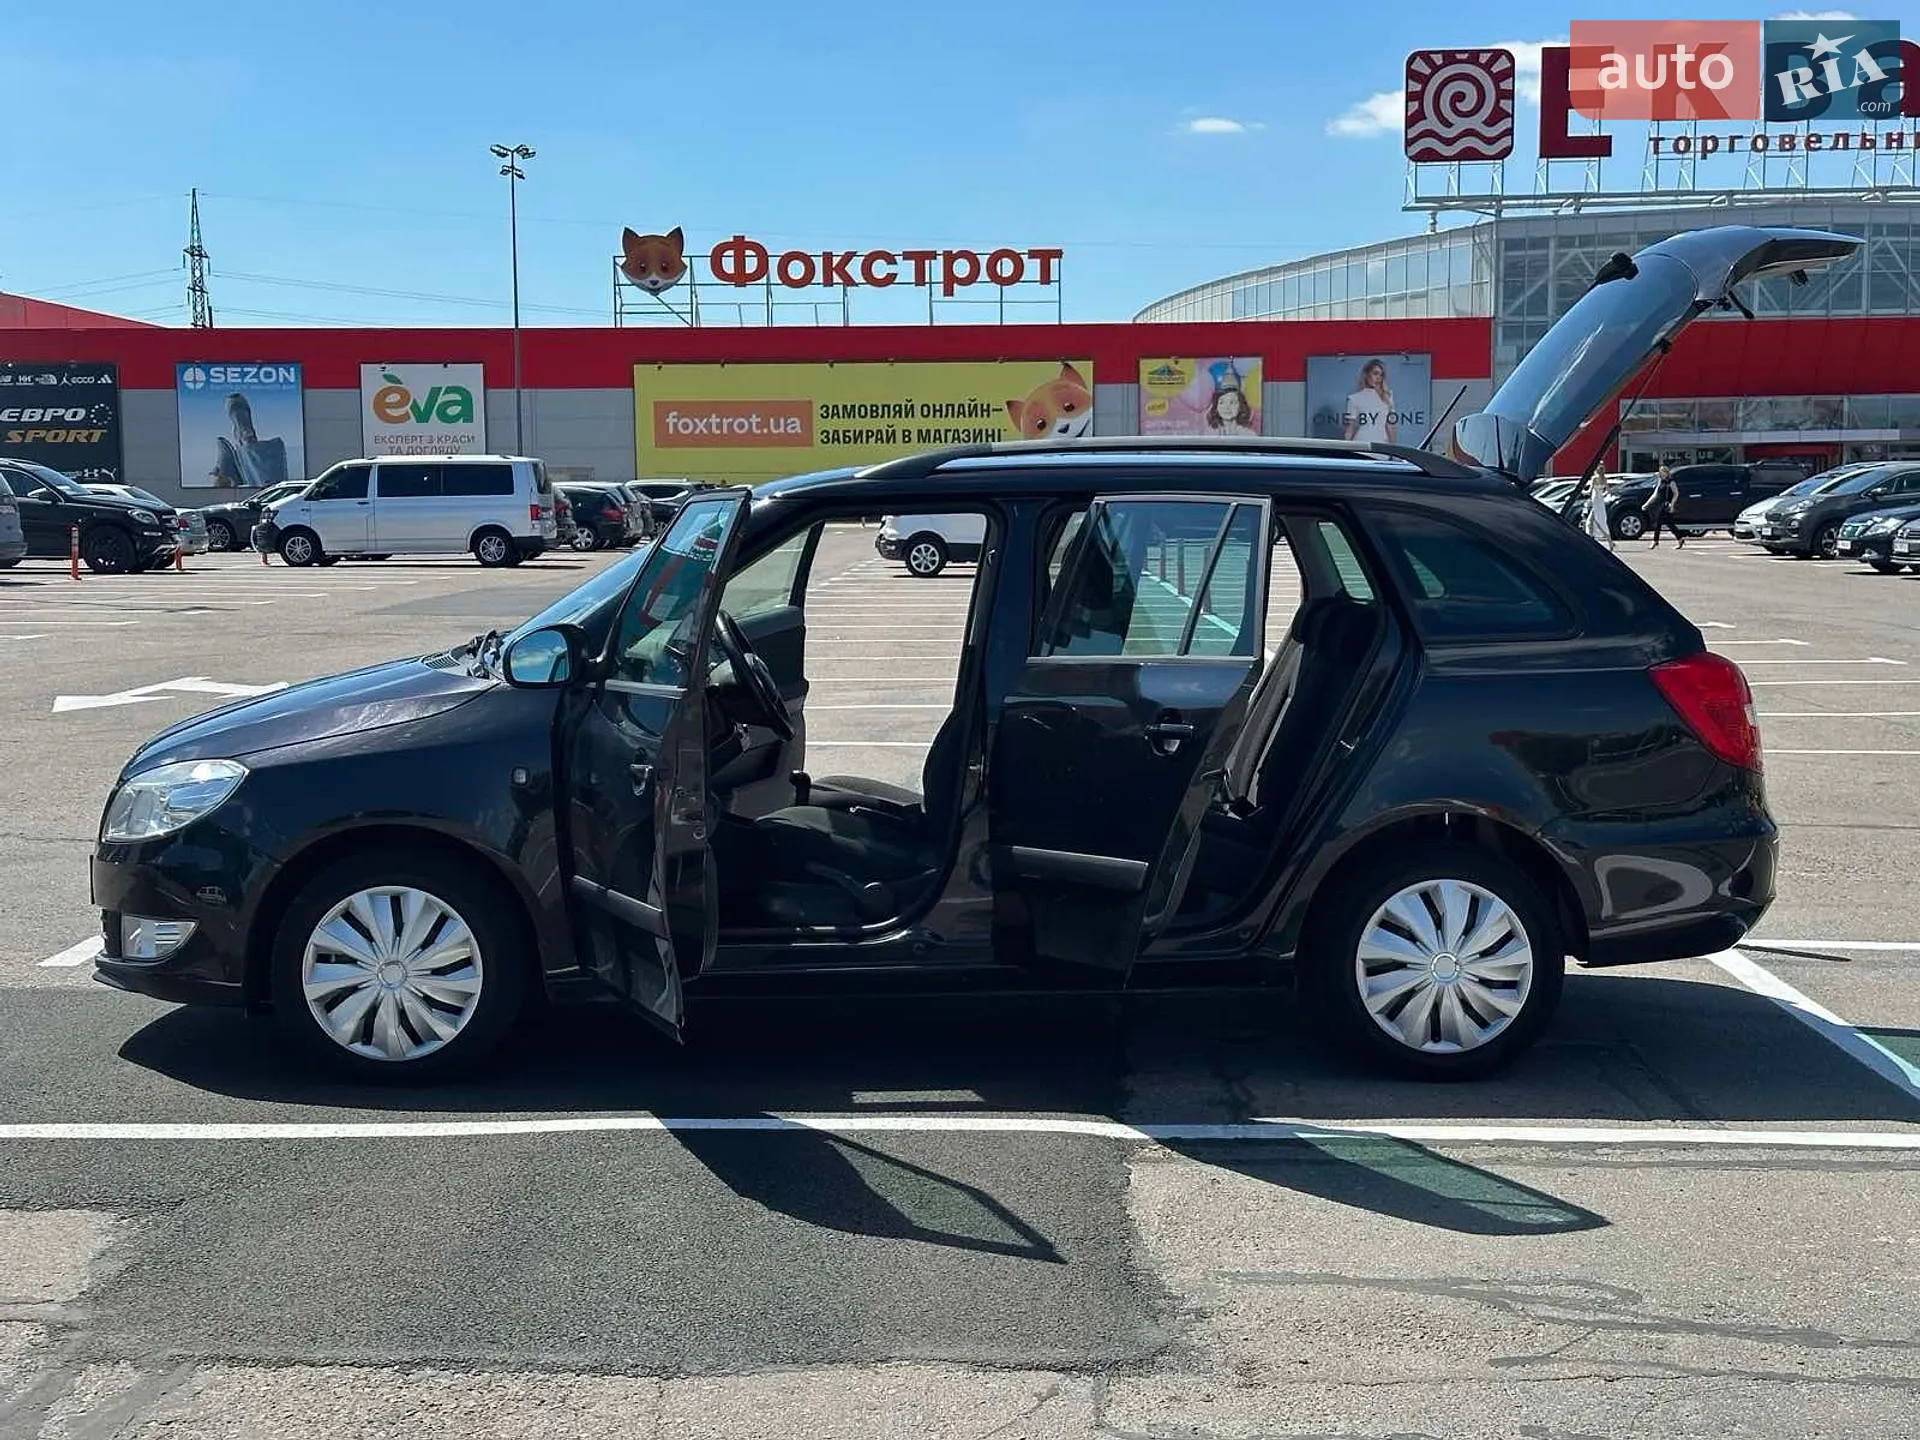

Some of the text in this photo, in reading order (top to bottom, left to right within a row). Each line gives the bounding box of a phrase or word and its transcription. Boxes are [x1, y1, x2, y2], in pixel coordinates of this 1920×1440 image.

[710, 235, 1063, 296] Фокстрот
[209, 367, 295, 383] SEZON
[0, 408, 86, 421] ЕВРО
[820, 398, 915, 419] ЗАМОВЛЯЙ
[666, 411, 802, 434] foxtrot.ua
[1313, 411, 1424, 425] ONE BY ONE
[4, 429, 107, 443] SPORT
[374, 435, 423, 445] ЕКСПЕРТ
[437, 434, 475, 444] КРАСИ
[820, 424, 896, 444] ЗАБИРАЙ
[902, 429, 912, 444] В
[388, 445, 460, 455] ТА ДОГЛЯДУ
